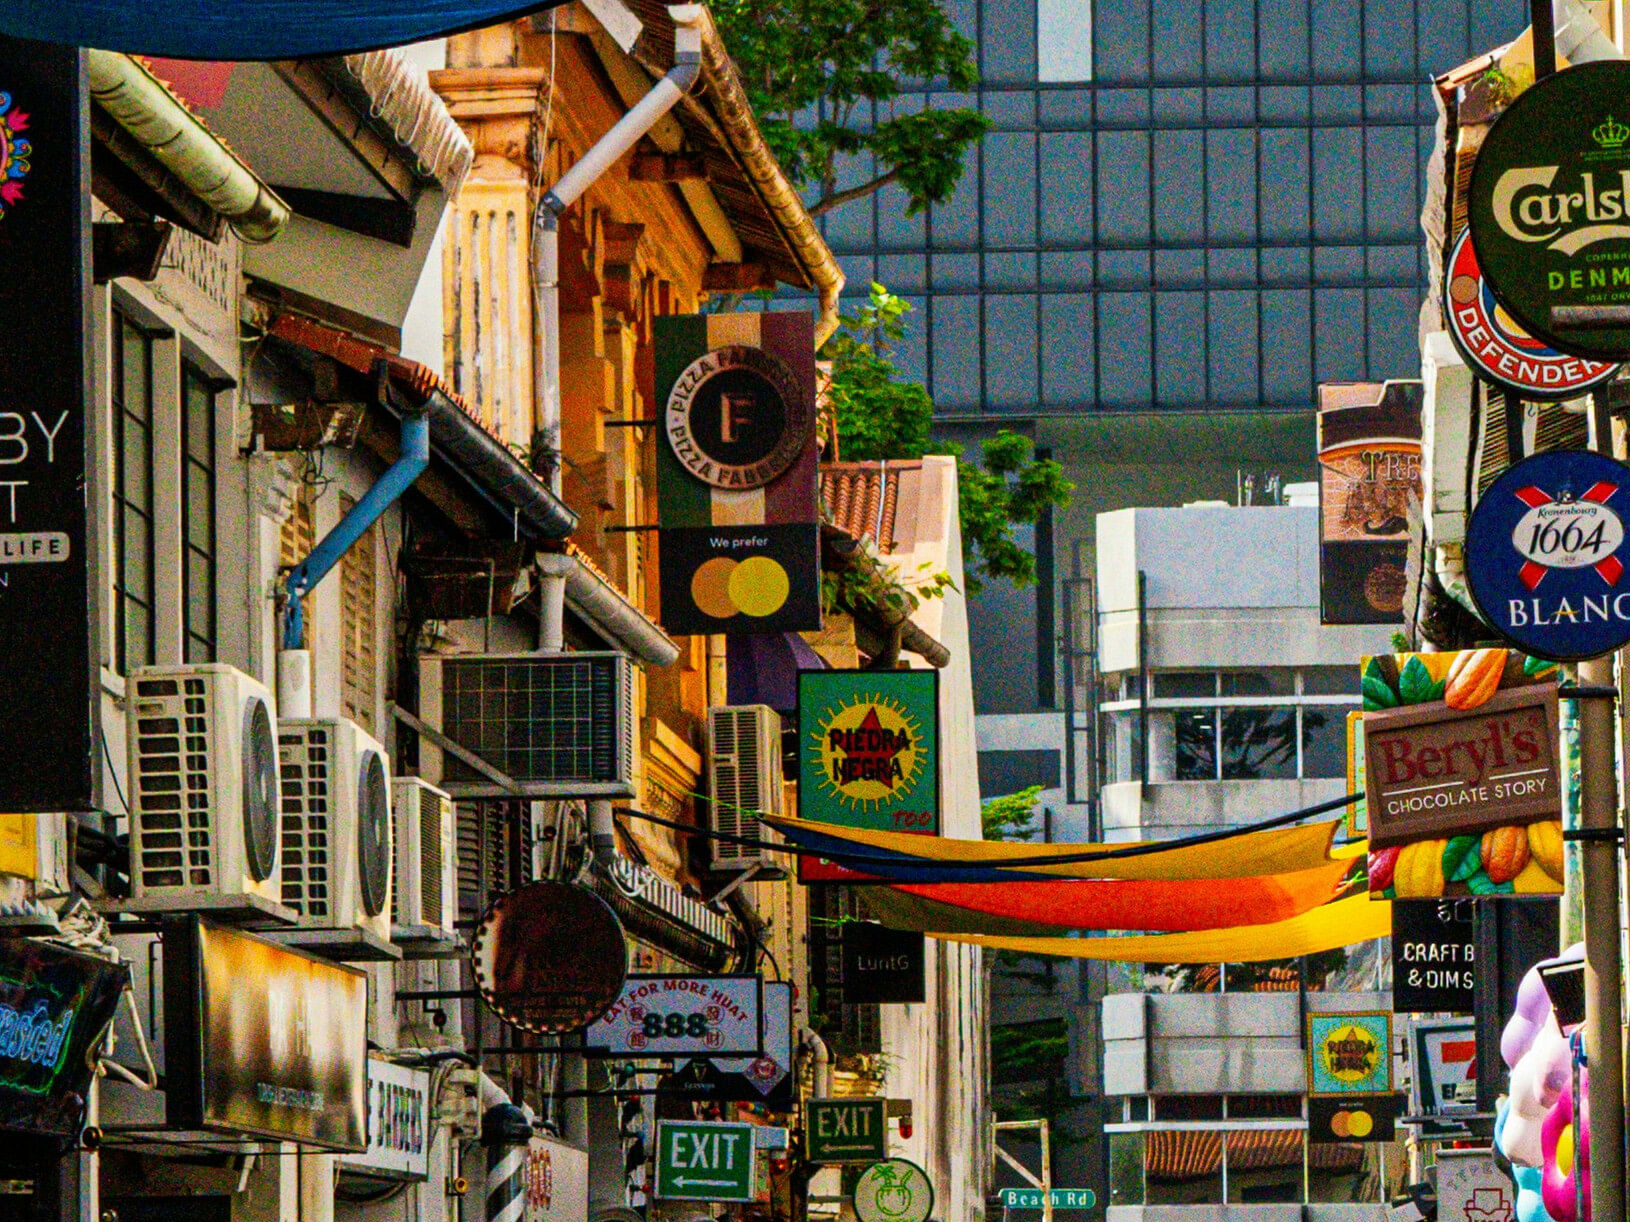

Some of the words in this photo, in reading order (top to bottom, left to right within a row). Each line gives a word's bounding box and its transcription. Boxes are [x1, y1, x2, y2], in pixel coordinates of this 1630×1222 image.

[671, 360, 714, 413] PIZZA
[670, 423, 712, 479] PIZZA
[1537, 505, 1598, 519] Kronenbourg
[4, 539, 60, 556] LIFE
[709, 536, 729, 548] We
[732, 535, 768, 554] prefer
[1529, 517, 1611, 556] 1664
[829, 727, 912, 751] PIEDRA
[1379, 718, 1540, 787] Beryl's
[832, 756, 905, 782] NEGRA
[1387, 786, 1489, 815] CHOCOLATE
[1494, 778, 1547, 799] STORY
[892, 811, 932, 827] TOO
[1404, 942, 1459, 962] CRAFT
[1408, 968, 1422, 987] &
[1426, 970, 1459, 989] DIM
[602, 998, 630, 1025] EAT
[628, 982, 659, 1004] FOR
[664, 979, 710, 998] MORE
[711, 989, 749, 1023] HUAT
[642, 1012, 709, 1039] 888
[819, 1106, 874, 1137] EXIT
[670, 1131, 740, 1170] EXIT
[1067, 1191, 1087, 1206] Rd
